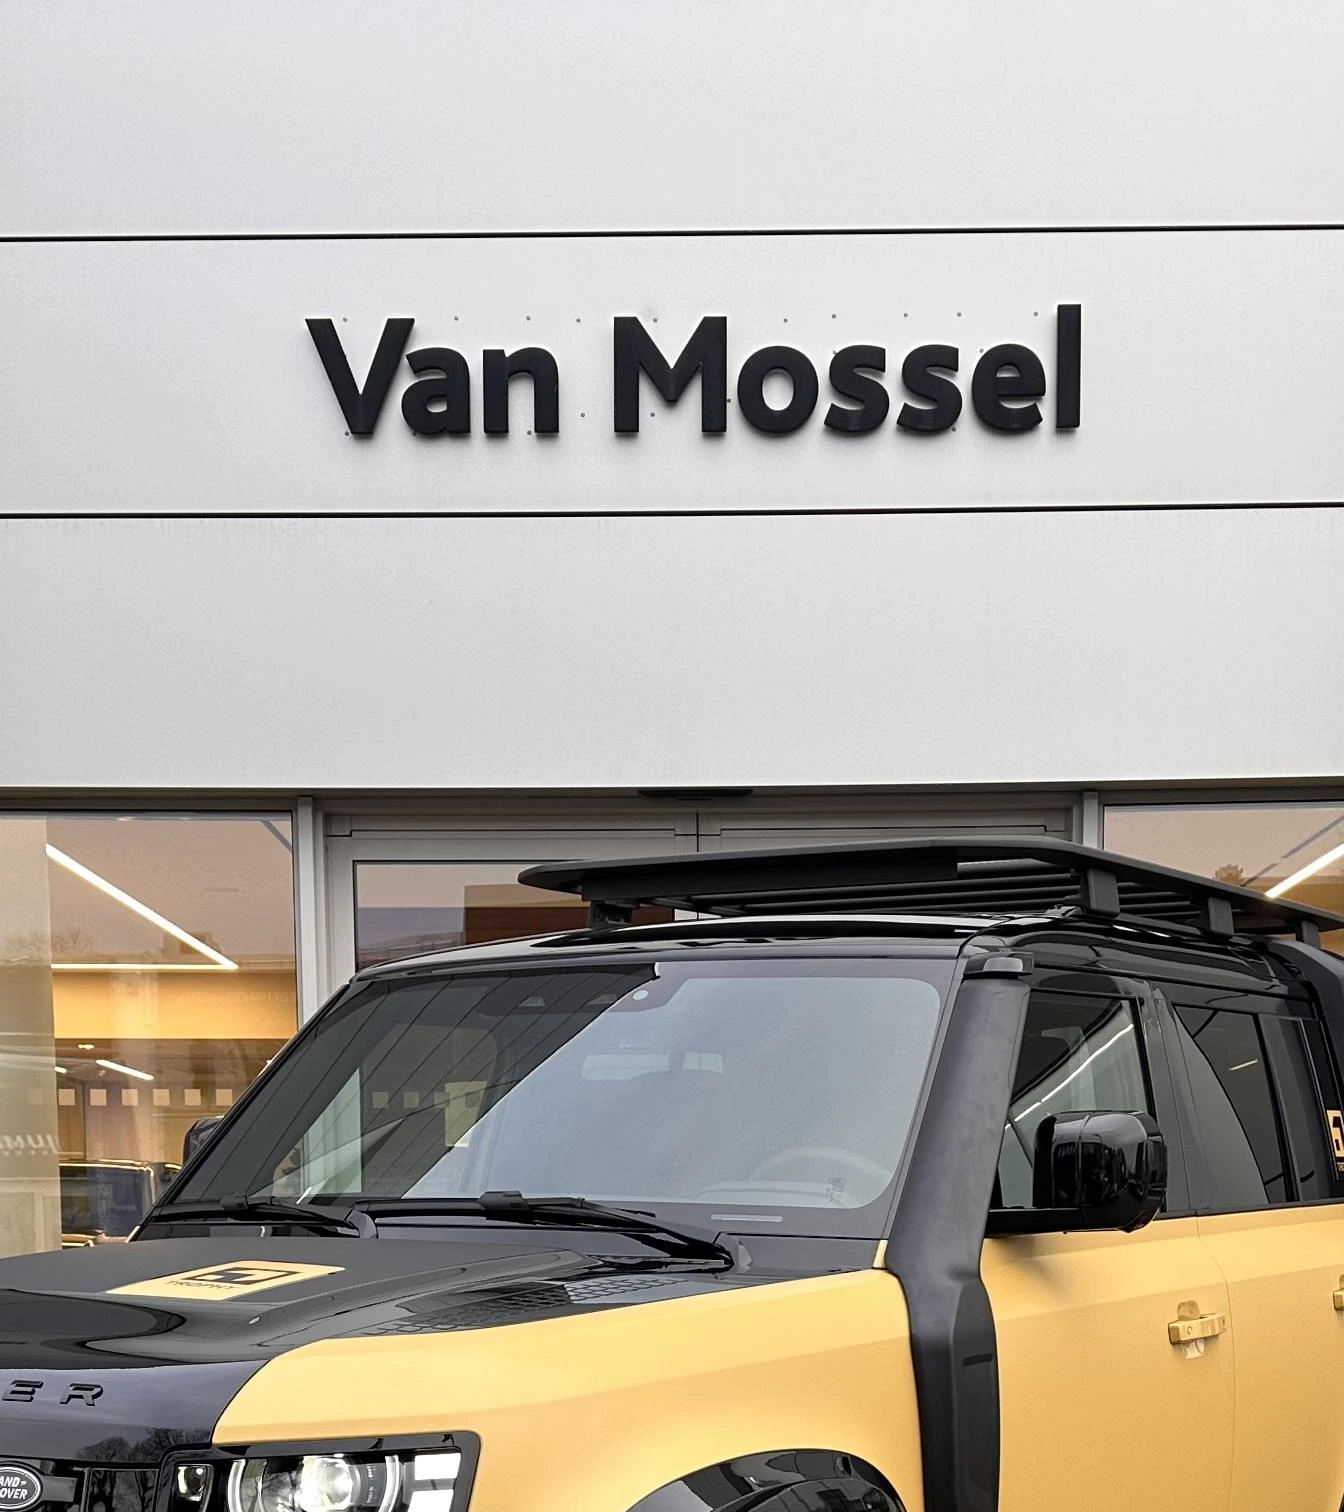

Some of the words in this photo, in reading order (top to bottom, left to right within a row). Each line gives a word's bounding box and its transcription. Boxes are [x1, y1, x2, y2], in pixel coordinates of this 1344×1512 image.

[304, 317, 560, 437] Van
[612, 303, 1082, 435] Mossel
[166, 1280, 241, 1291] TROPHY
